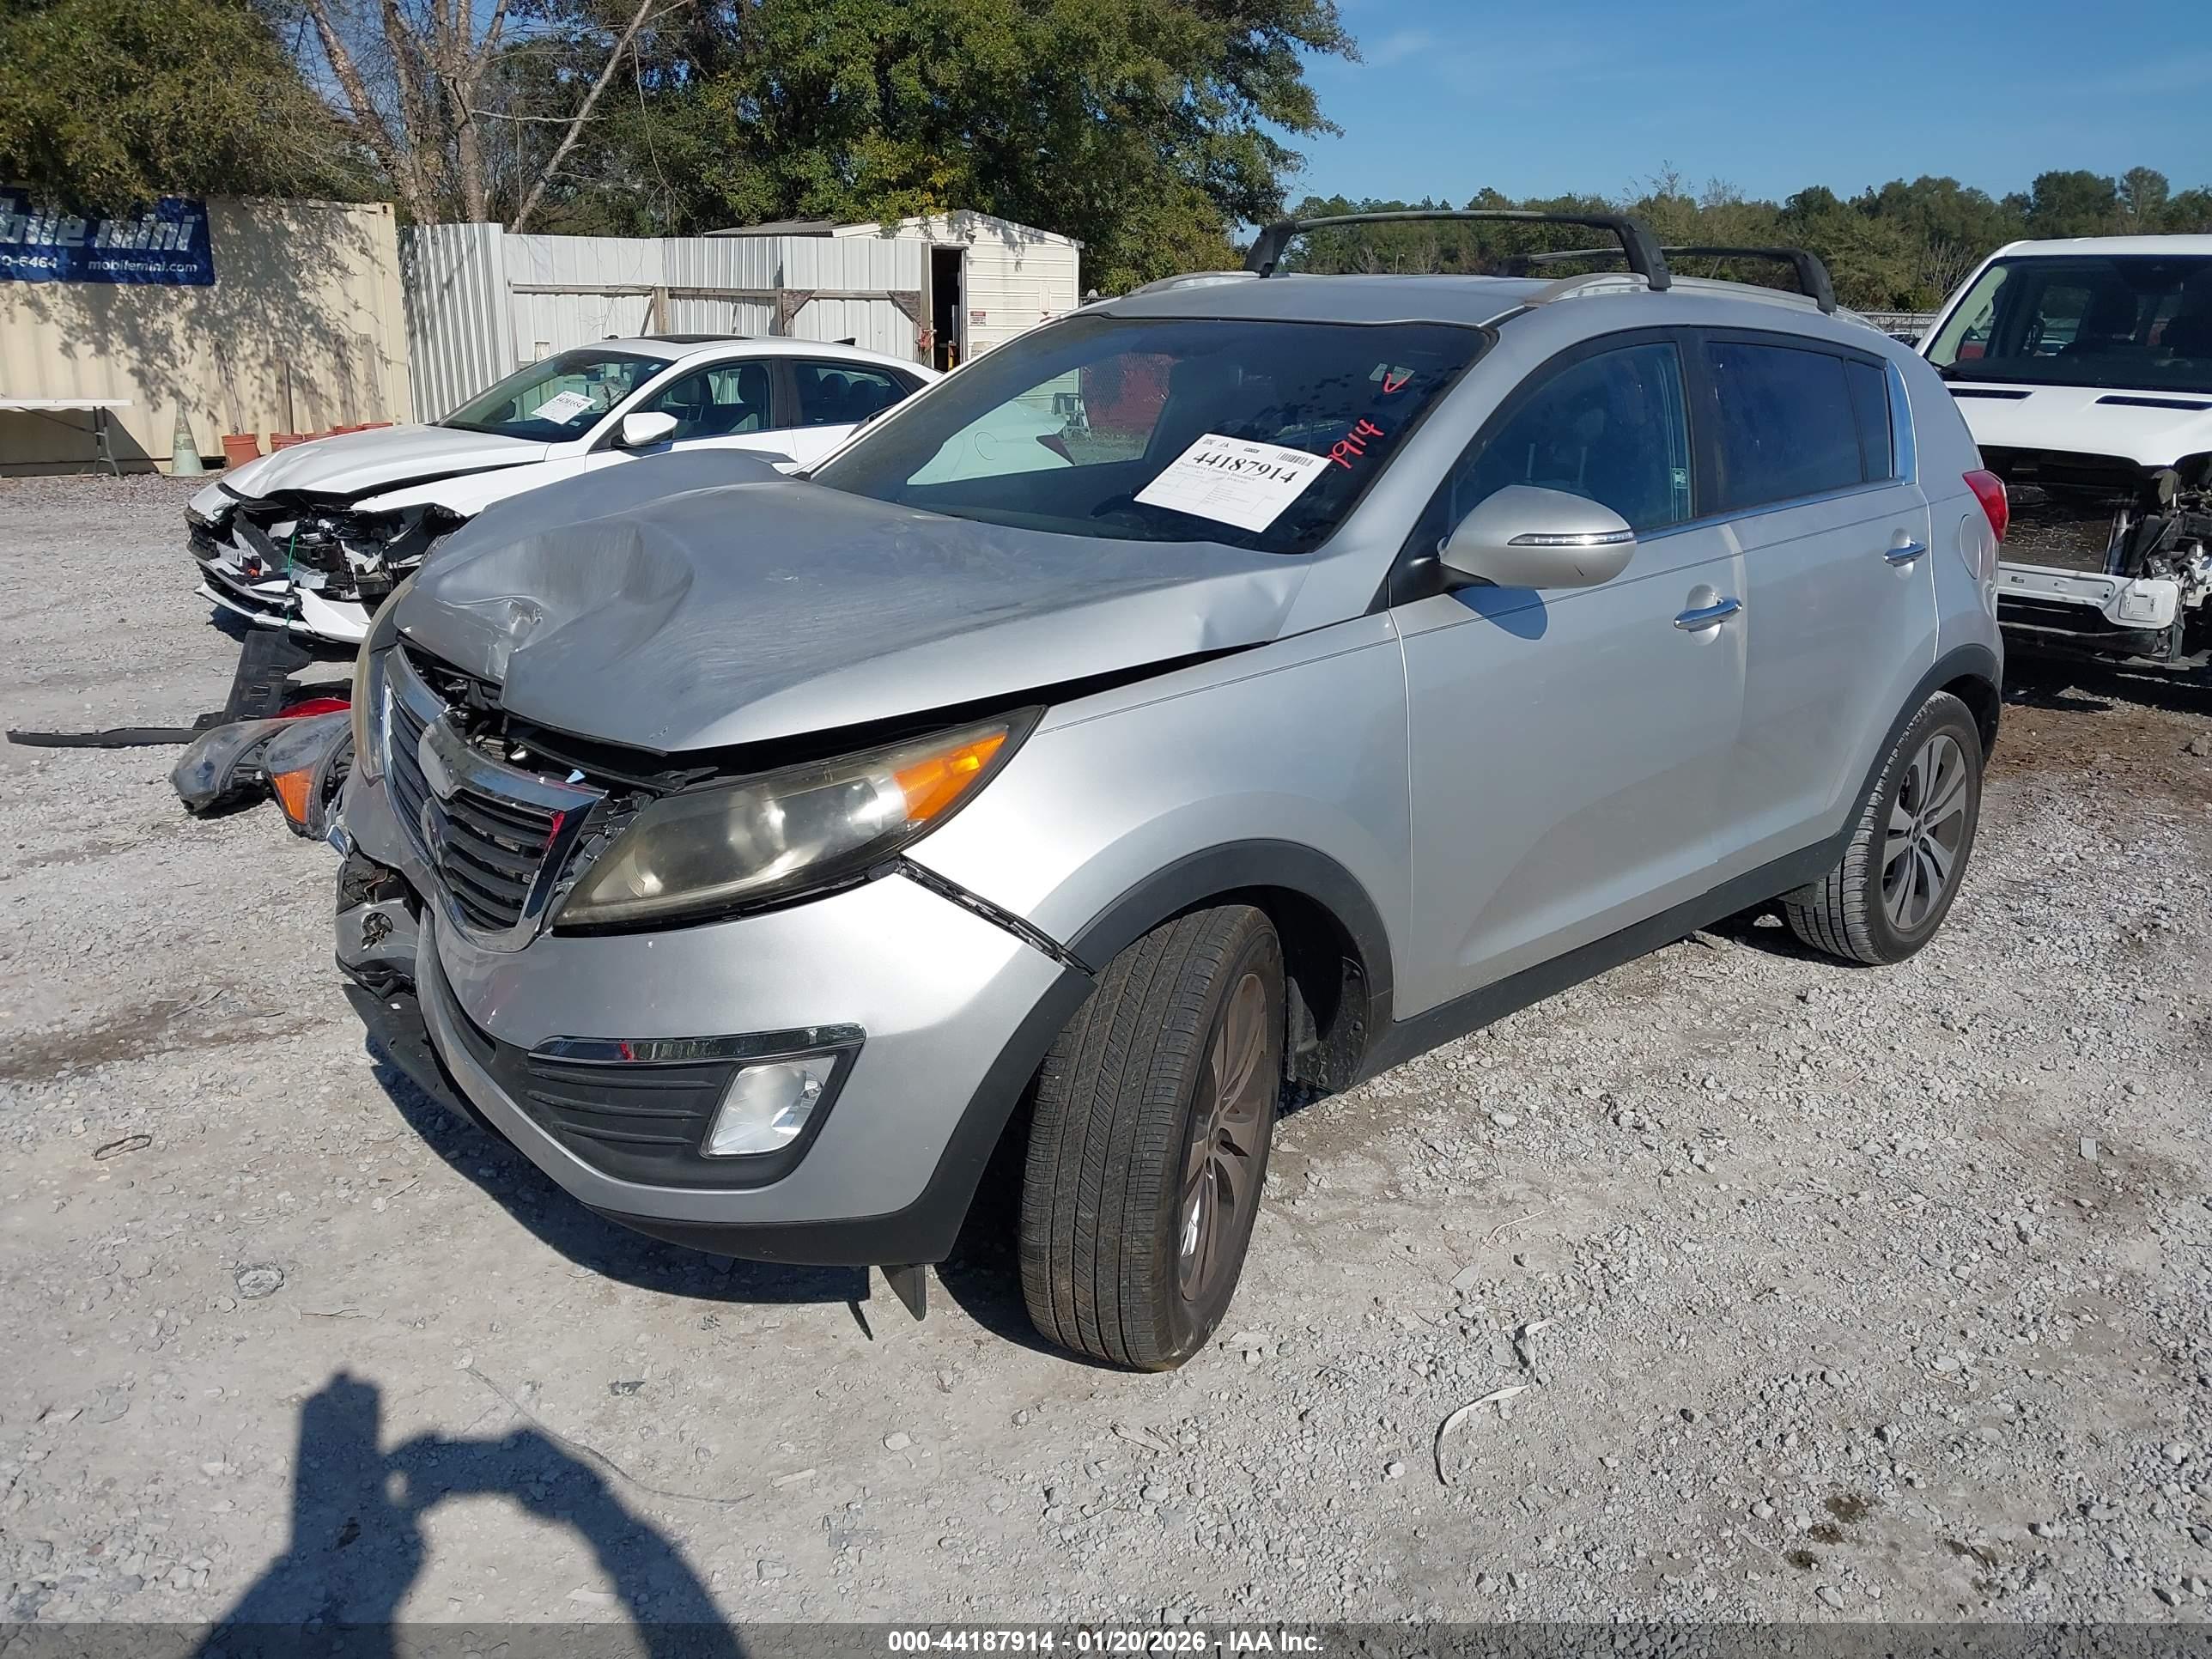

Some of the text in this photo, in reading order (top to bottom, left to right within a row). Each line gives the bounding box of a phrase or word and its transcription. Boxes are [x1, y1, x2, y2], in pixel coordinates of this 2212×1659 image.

[94, 214, 195, 251] mini
[0, 255, 198, 272] 0-6464 mobilemini.com
[1327, 418, 1385, 469] 1914
[1193, 452, 1298, 483] 44187914
